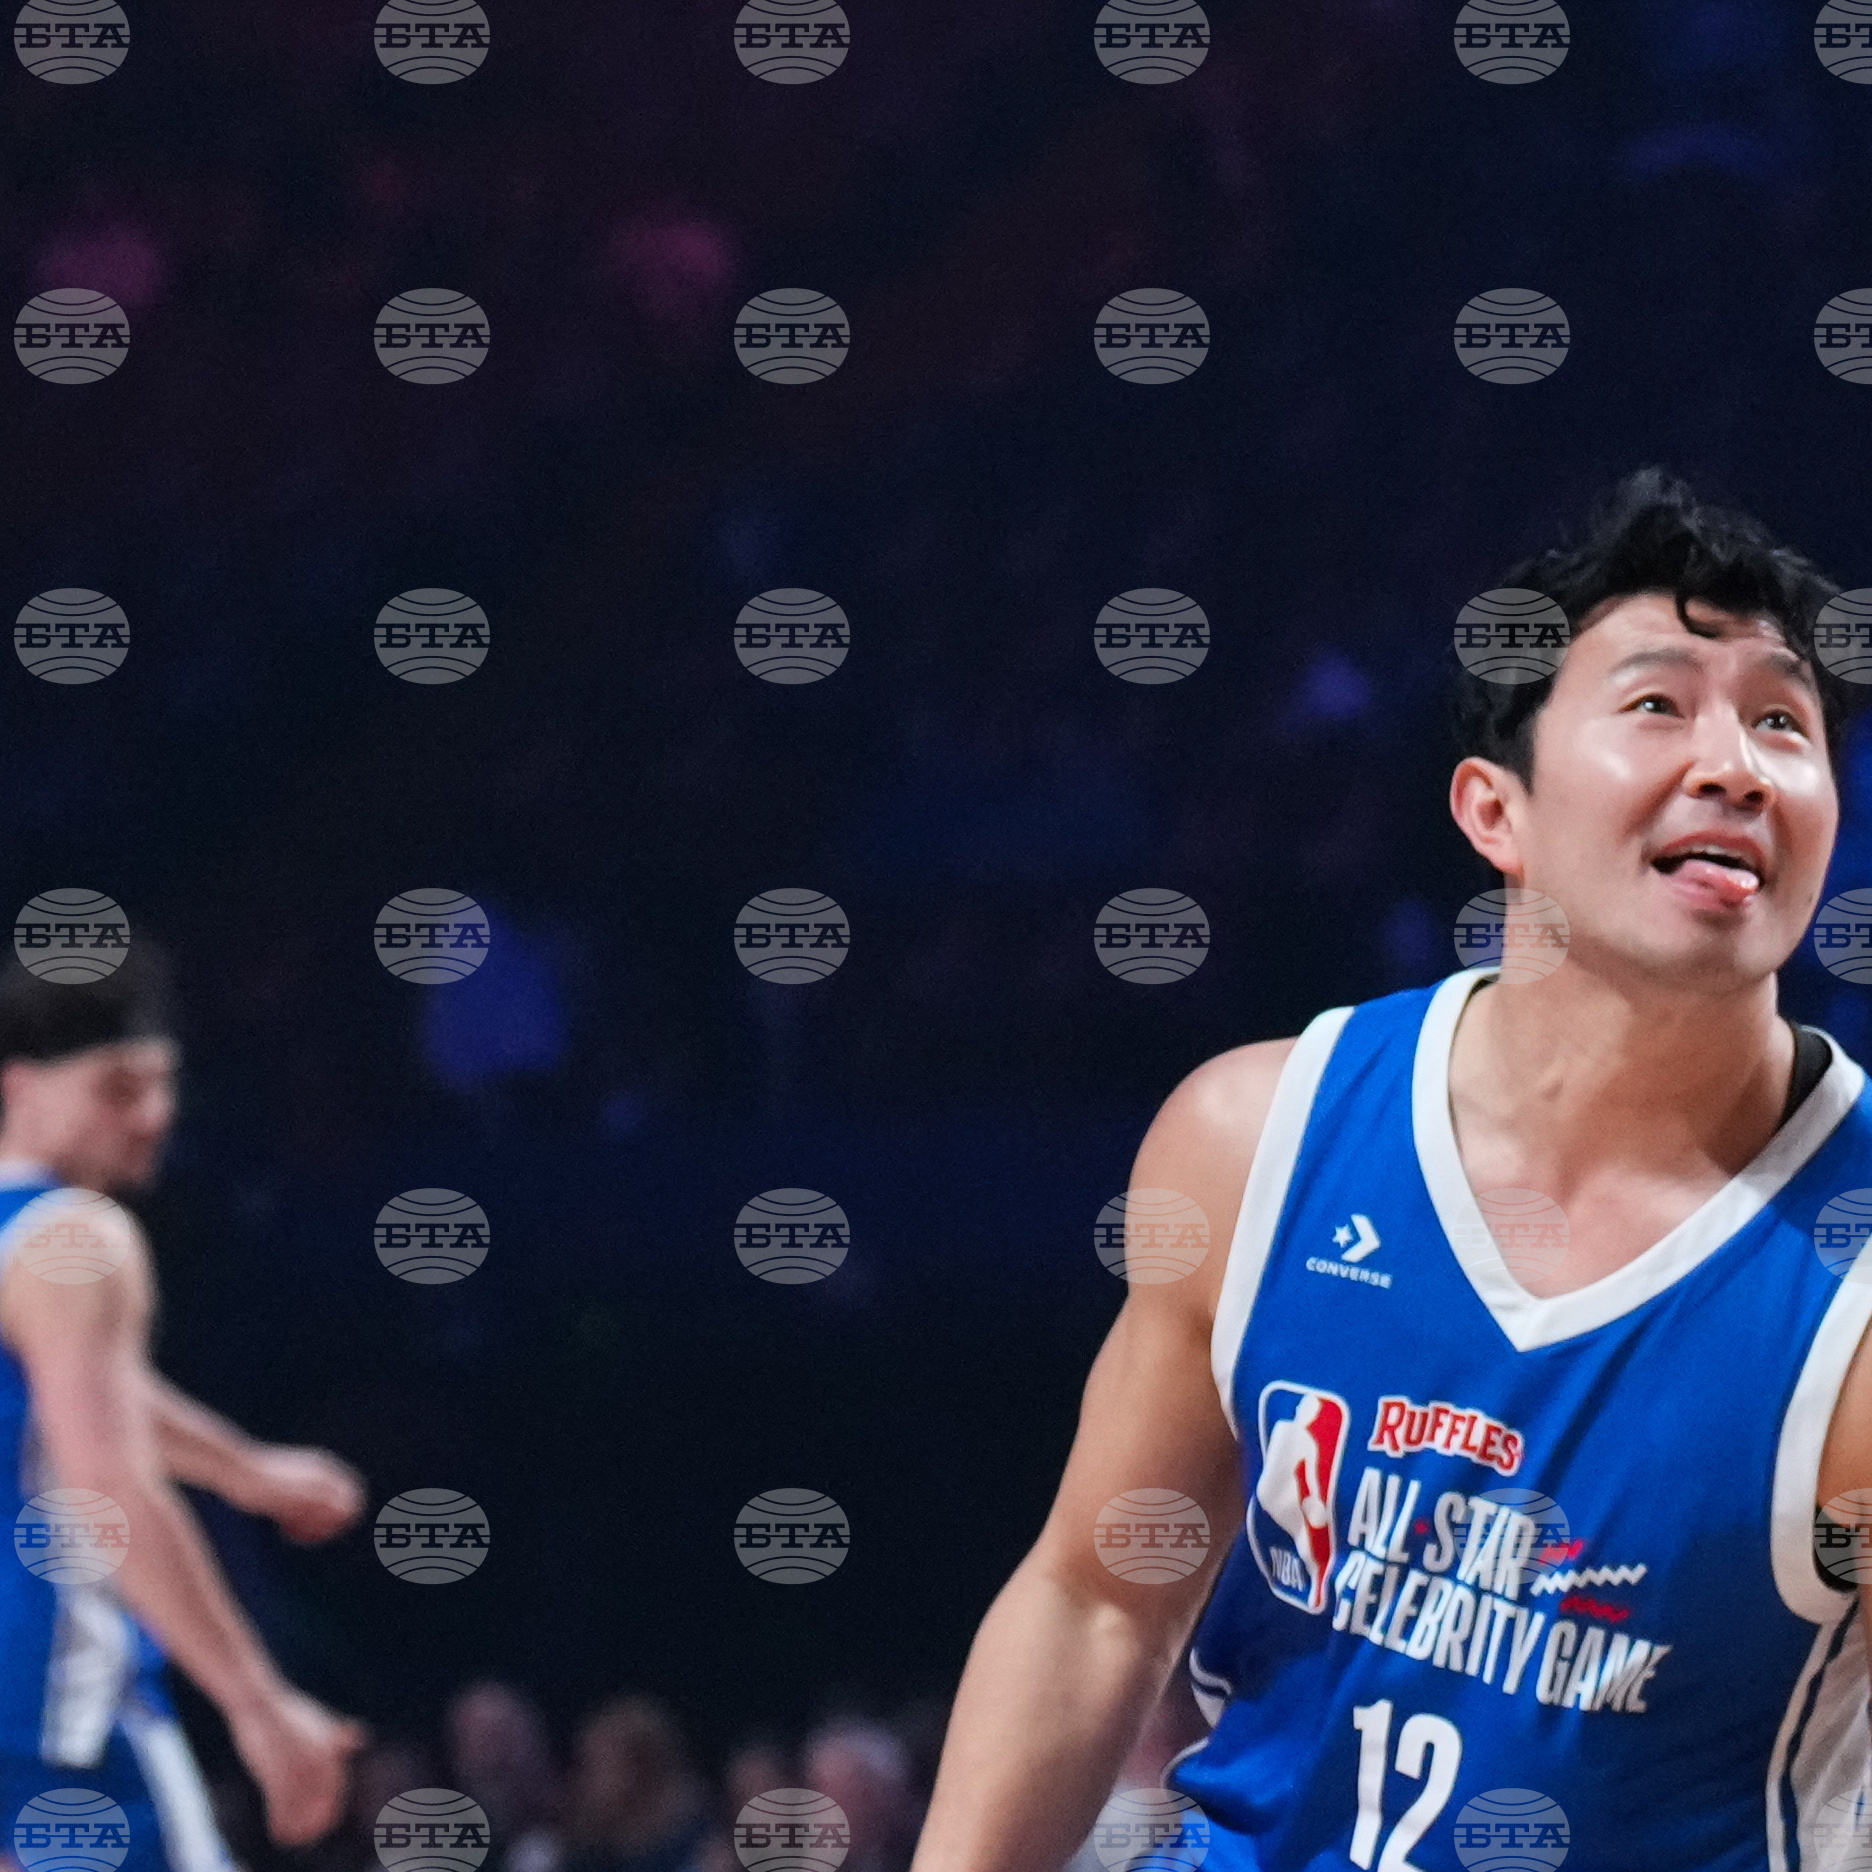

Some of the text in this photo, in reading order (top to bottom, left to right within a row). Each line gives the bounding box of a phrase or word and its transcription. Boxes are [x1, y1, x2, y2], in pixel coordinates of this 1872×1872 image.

[1305, 1255, 1392, 1289] CONVERSE
[1371, 1396, 1523, 1475] RUFFLES
[1269, 1545, 1306, 1593] NBA
[1332, 1550, 1672, 1713] CELEBRITY GAME
